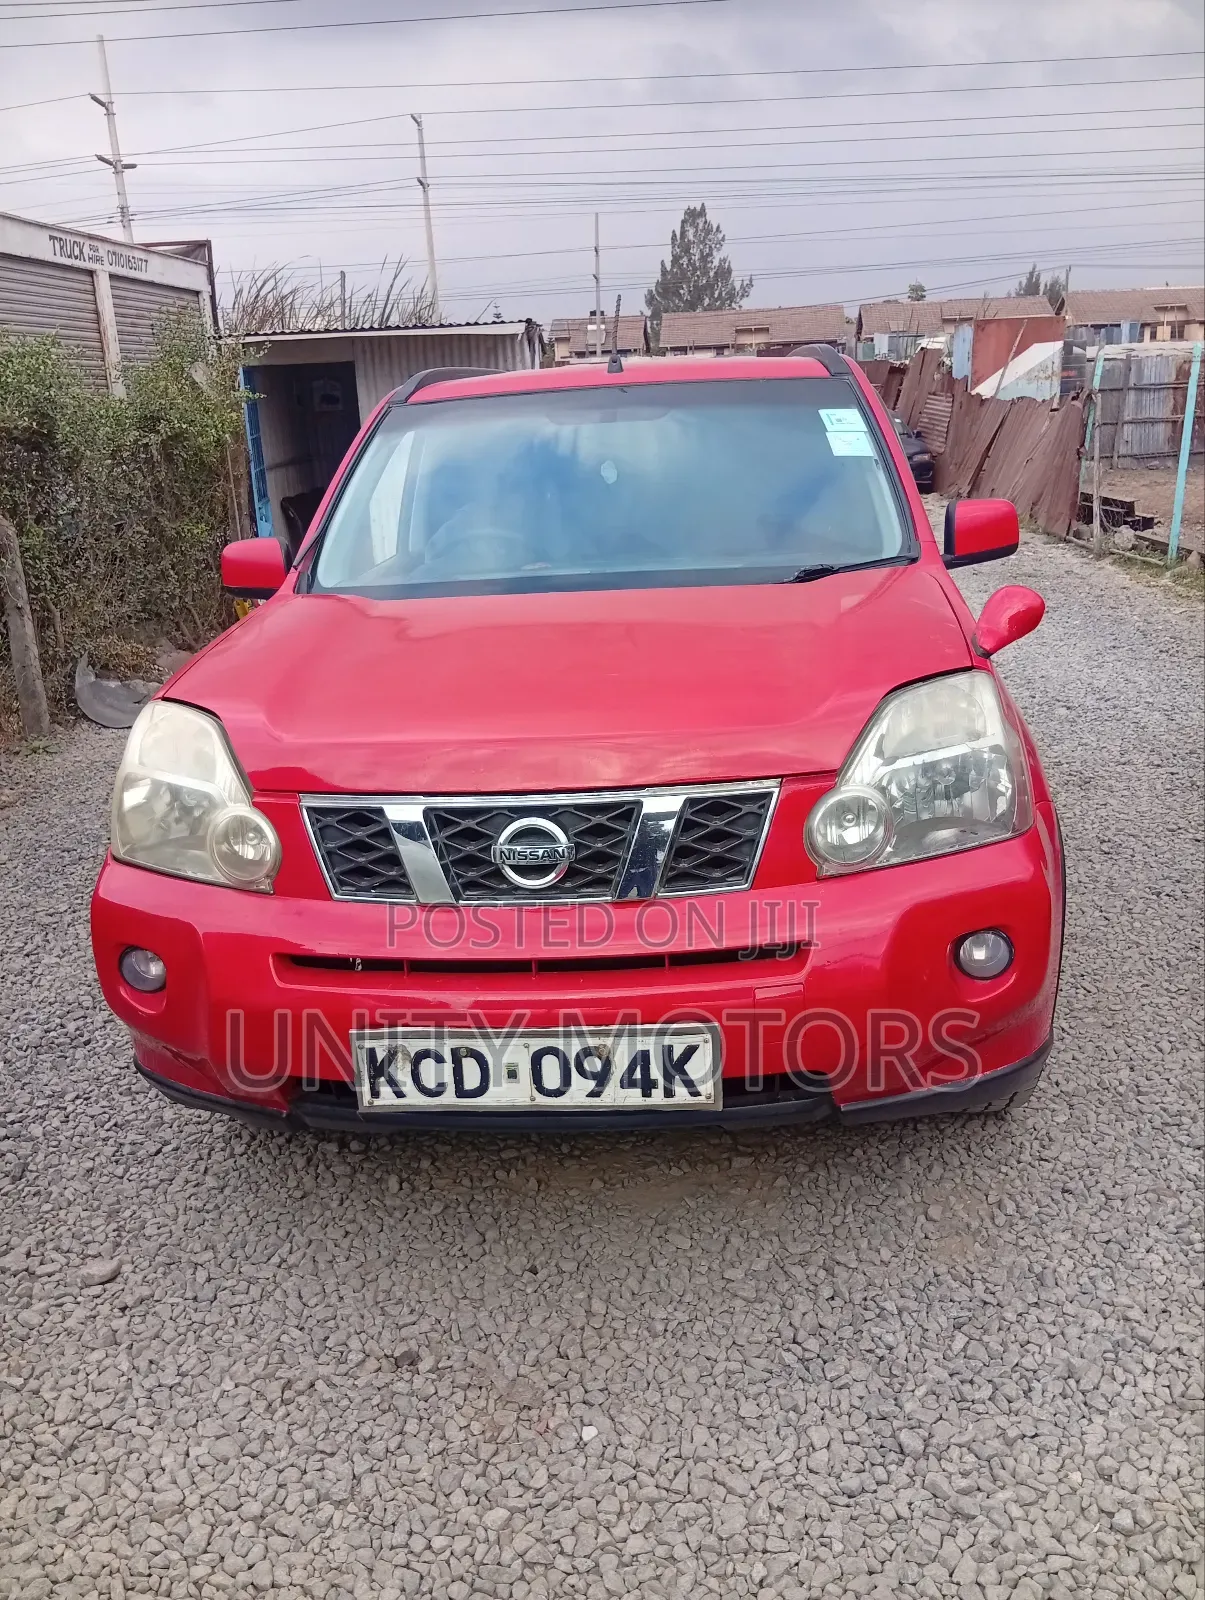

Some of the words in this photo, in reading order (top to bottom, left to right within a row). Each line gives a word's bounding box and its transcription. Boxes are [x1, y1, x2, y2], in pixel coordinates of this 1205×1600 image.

[49, 234, 86, 262] TRUCK
[88, 243, 100, 254] FOR
[87, 253, 105, 266] HIRE
[107, 250, 148, 273] 0710163177
[500, 848, 566, 861] NISSAN
[366, 1046, 491, 1099] KCD
[530, 1044, 702, 1098] 094K
